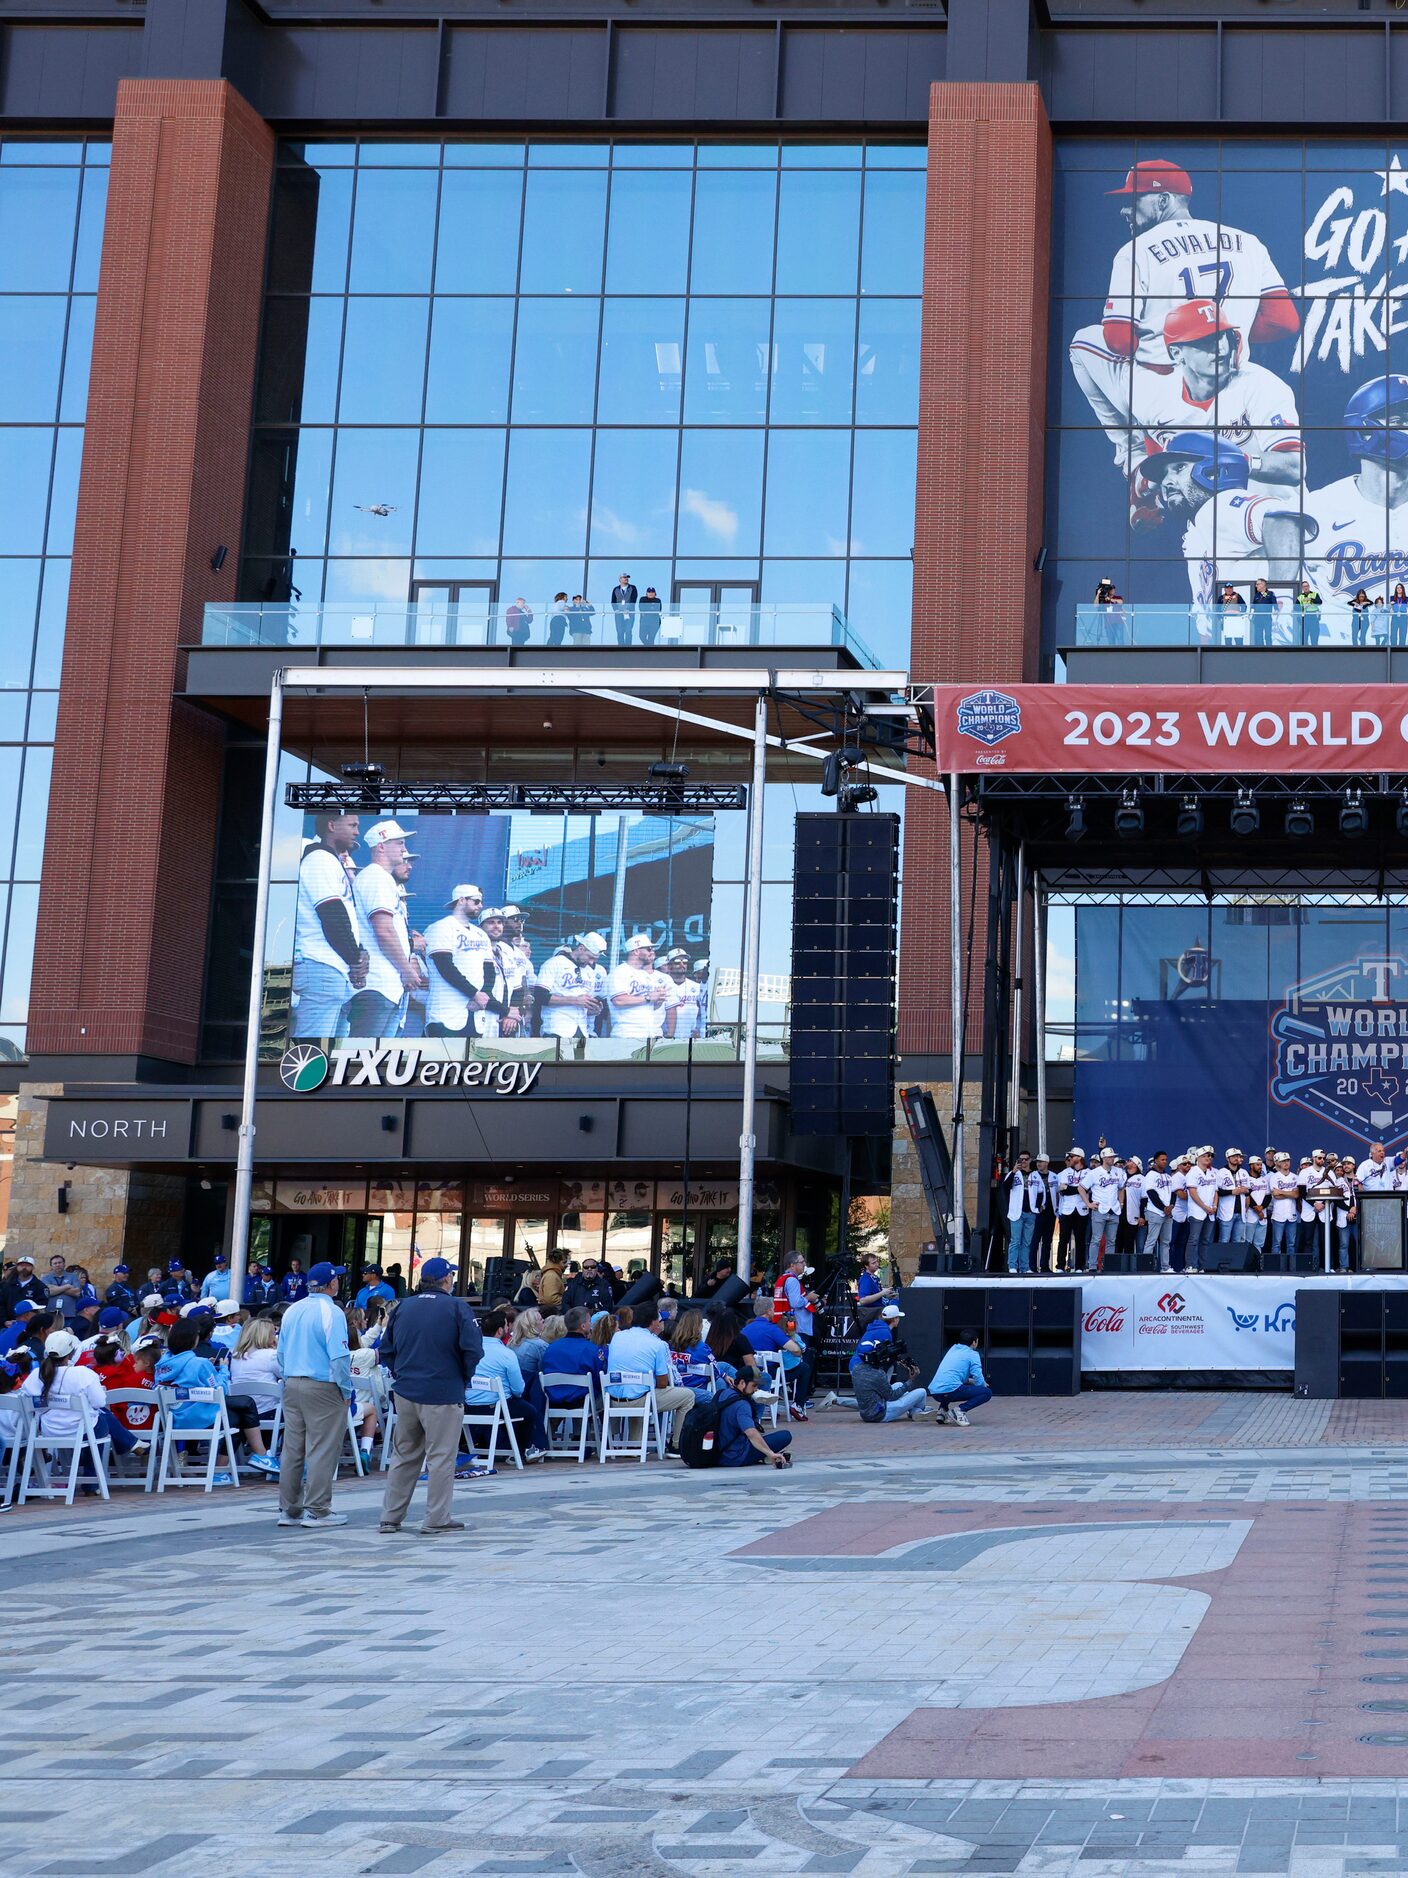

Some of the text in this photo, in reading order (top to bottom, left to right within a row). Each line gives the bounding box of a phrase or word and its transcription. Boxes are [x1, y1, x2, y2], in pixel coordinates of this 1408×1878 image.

[1304, 186, 1387, 274] GO
[1148, 233, 1244, 265] EOVALDI
[1178, 260, 1234, 304] 17
[1198, 305, 1218, 324] T
[983, 692, 994, 704] T
[973, 705, 1005, 714] WORLD
[962, 715, 1017, 726] CHAMPIONS
[1063, 710, 1180, 747] 2023
[1197, 710, 1382, 747] WORLD
[1362, 962, 1398, 1004] T
[329, 1049, 542, 1094] TXU energy
[1336, 1078, 1358, 1095] 20
[70, 1119, 168, 1138] NORTH
[294, 1191, 306, 1205] GO
[484, 1193, 550, 1202] WORLD SERIES
[670, 1191, 682, 1205] GO
[699, 1190, 717, 1206] TAKE
[719, 1191, 730, 1206] IT
[129, 1413, 148, 1423] TEXAS
